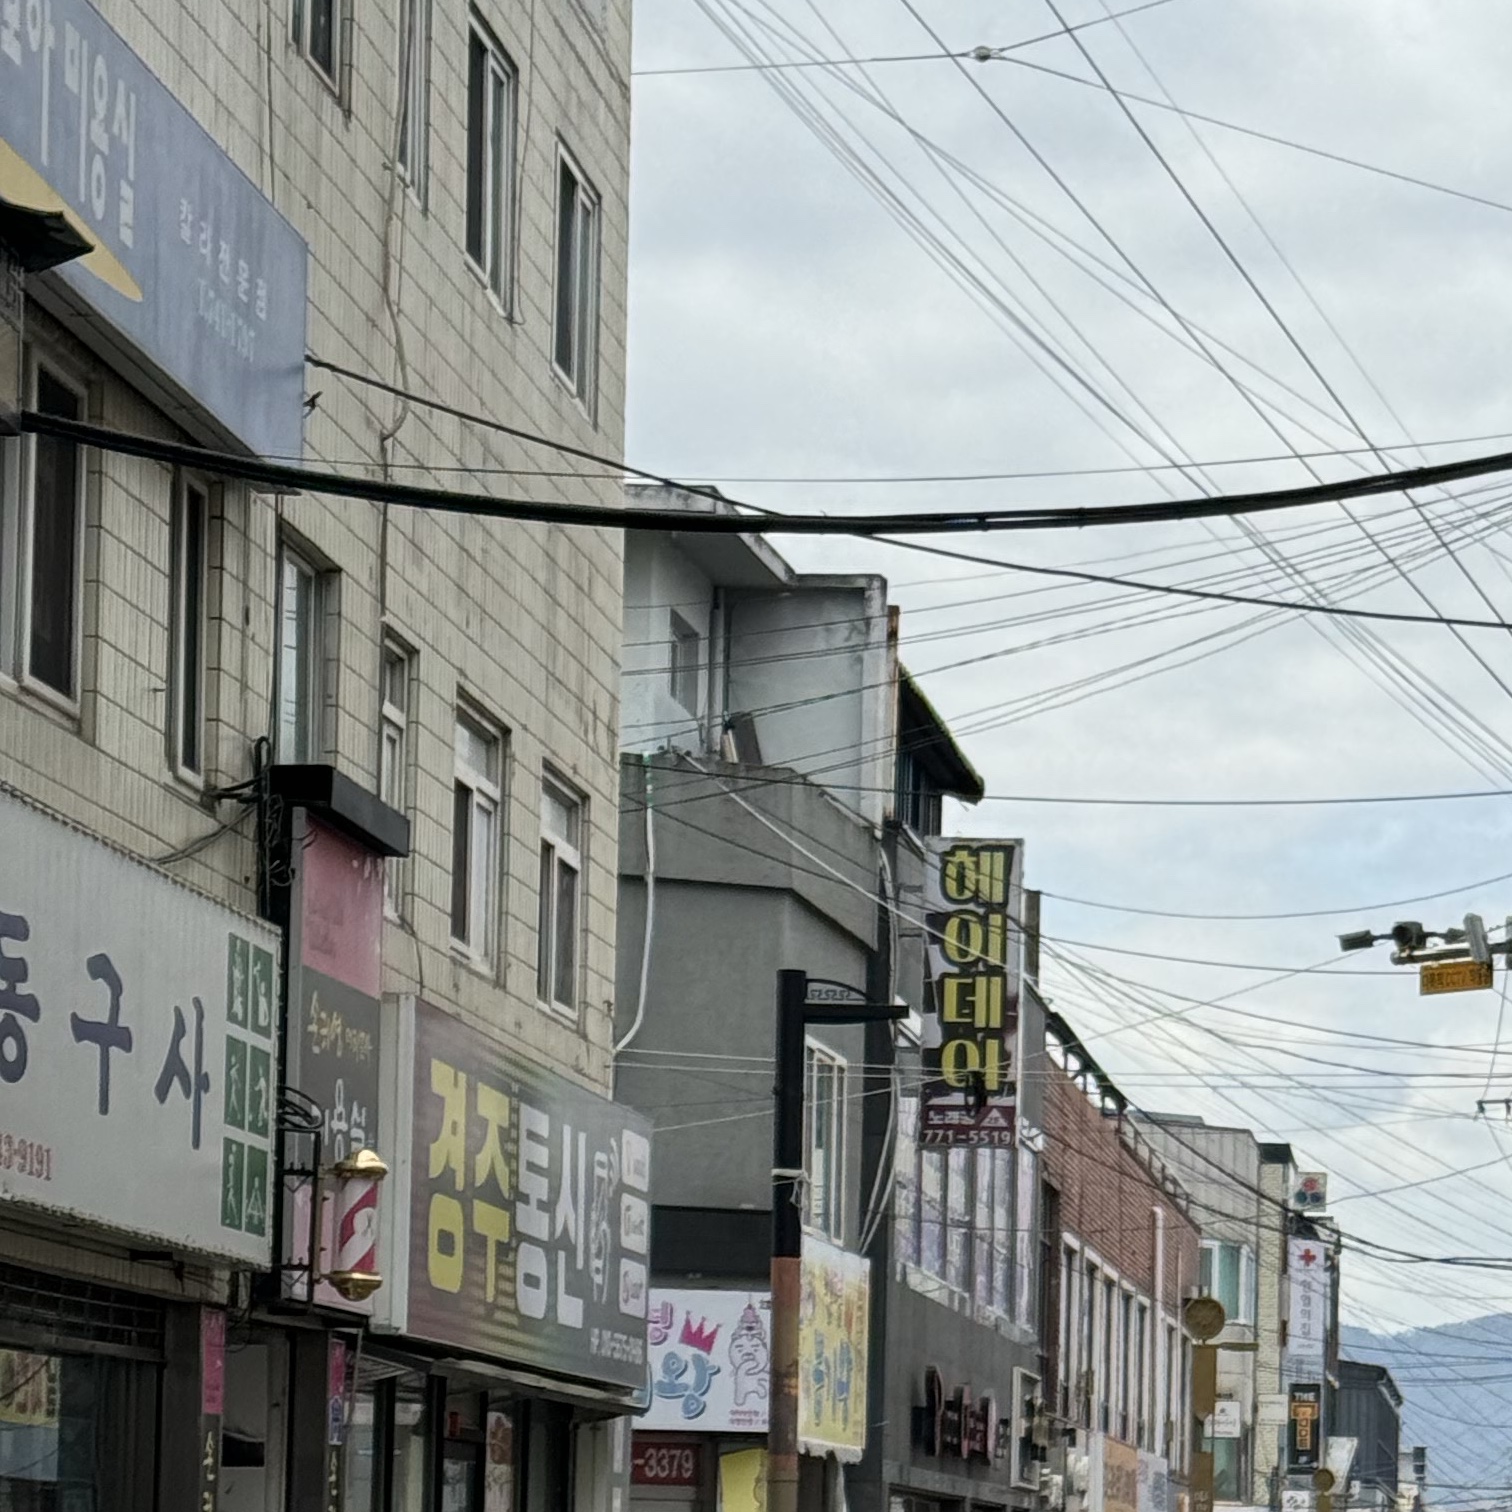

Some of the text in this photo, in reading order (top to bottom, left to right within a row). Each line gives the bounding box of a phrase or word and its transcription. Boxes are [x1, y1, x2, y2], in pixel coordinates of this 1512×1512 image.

[942, 849, 1004, 1091] 헤이데이
[311, 1078, 367, 1165] 용실
[923, 1130, 1012, 1146] 771-5519
